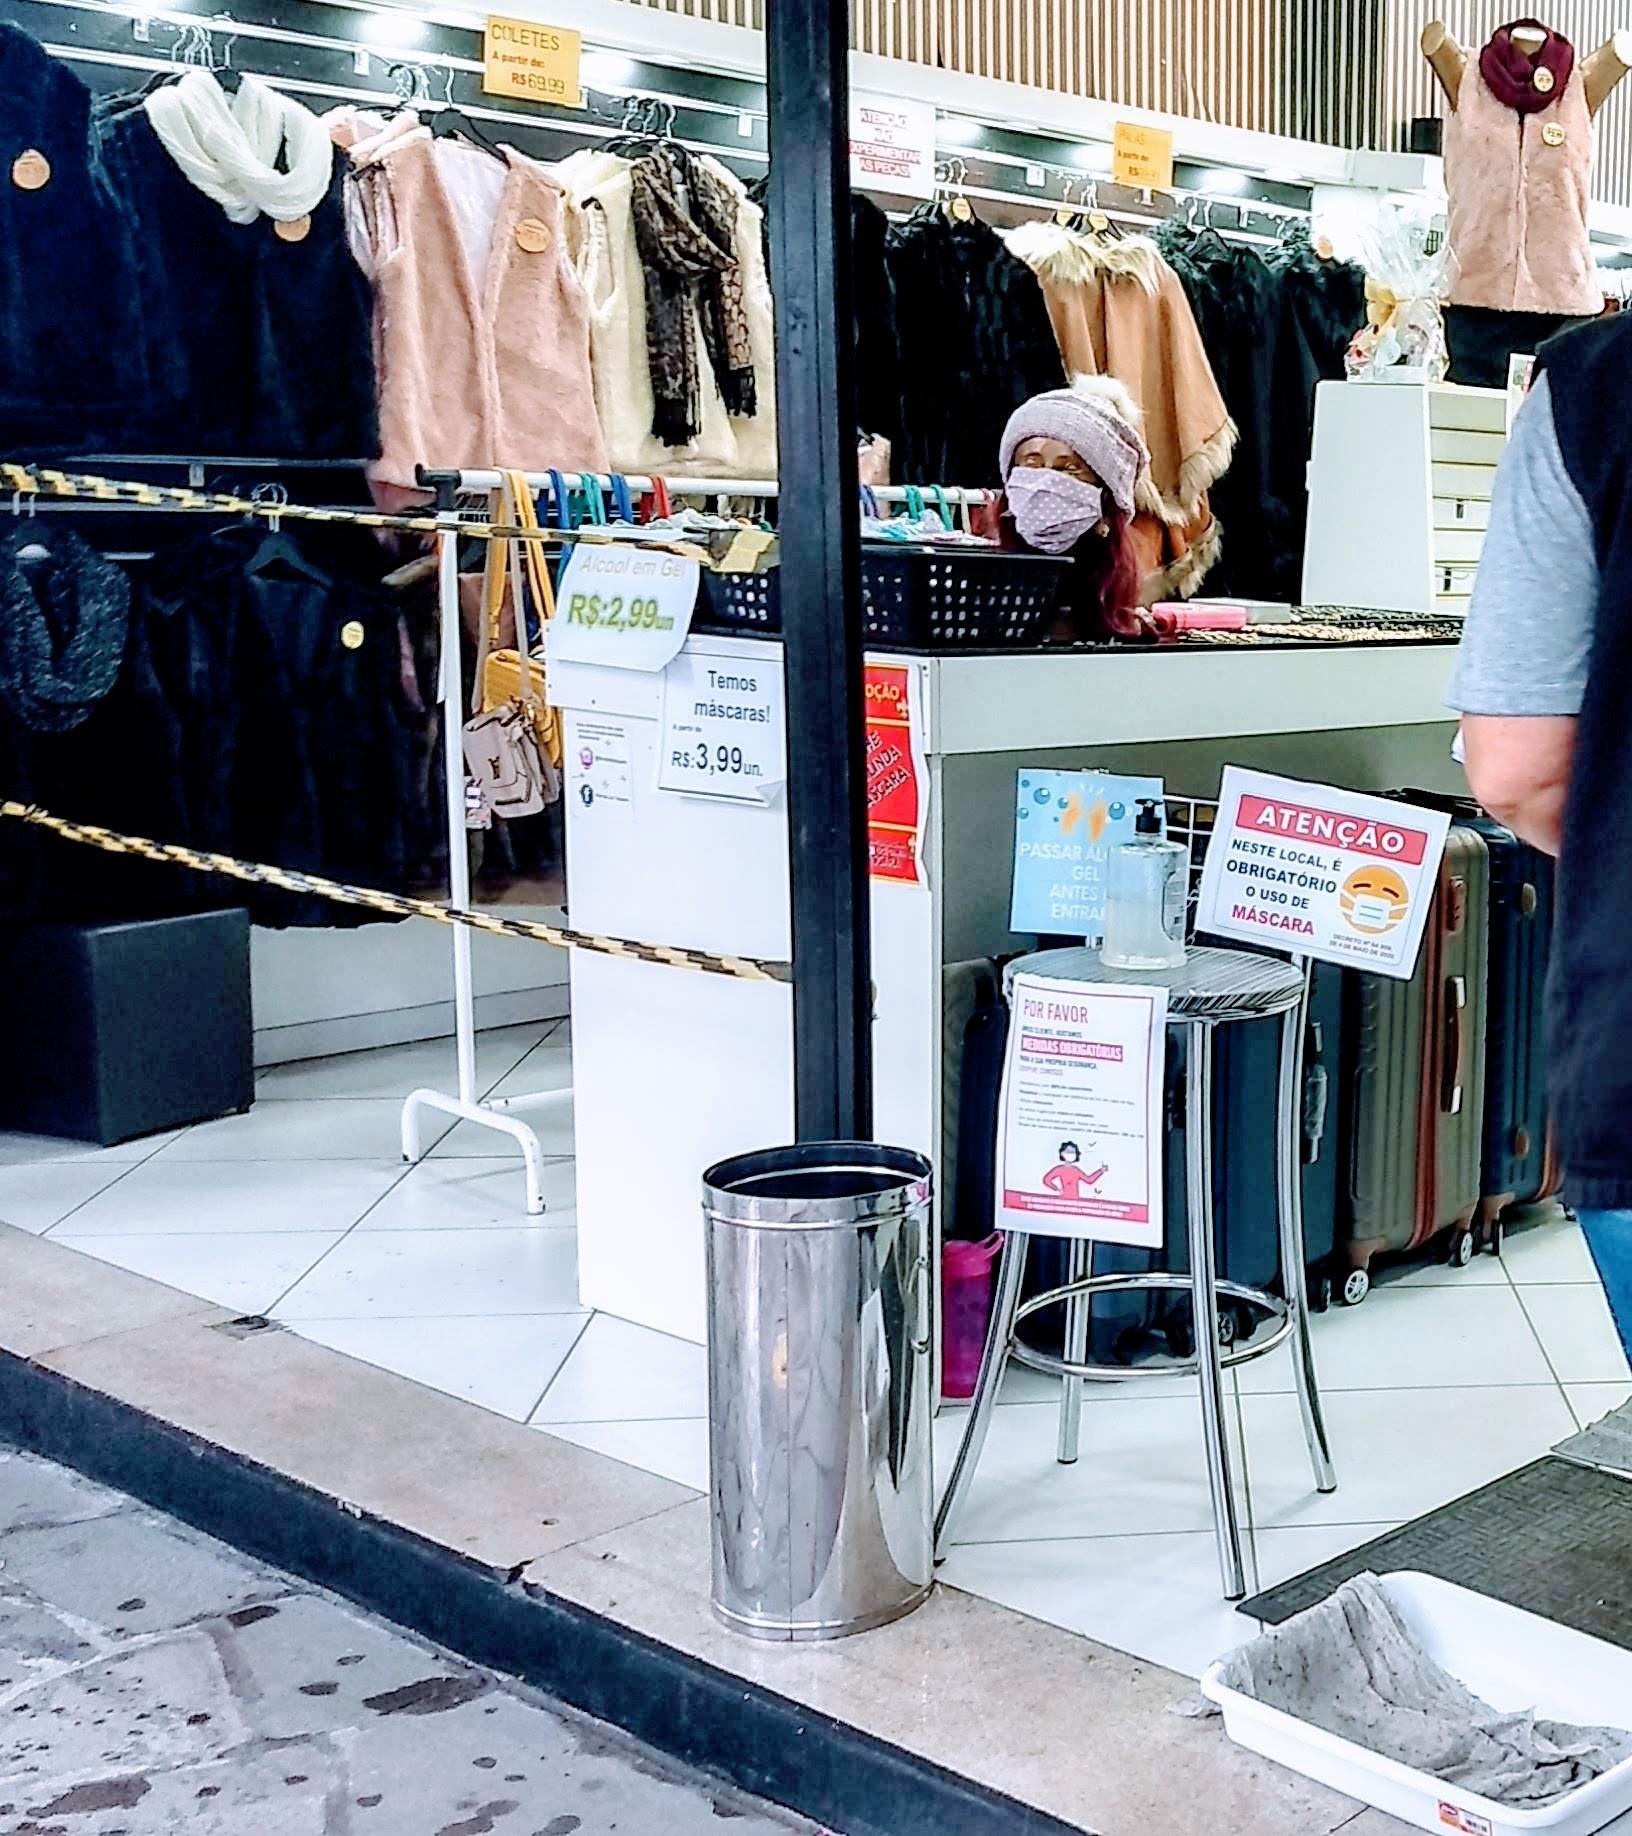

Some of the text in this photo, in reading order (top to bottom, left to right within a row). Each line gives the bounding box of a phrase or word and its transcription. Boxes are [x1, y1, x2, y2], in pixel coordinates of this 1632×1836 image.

[491, 24, 560, 51] COLETES
[492, 50, 499, 60] A
[580, 555, 687, 578] Alcool em Gel
[707, 670, 758, 692] Temos
[864, 681, 900, 703] OÇÃO
[694, 700, 771, 724] máscaras!
[1256, 804, 1405, 854] ATENÇÃO
[1020, 842, 1107, 862] PASSAR AL
[1232, 838, 1343, 872] NESTE LOCAL, É
[1072, 865, 1101, 882] GEL
[1226, 859, 1338, 894] OBRIGATÓRIO
[1049, 883, 1098, 901] ANTES
[1245, 886, 1310, 910] O USO DE
[1231, 904, 1315, 936] MÁSCARA
[1024, 999, 1089, 1024] POR FAVOR
[1060, 1040, 1121, 1060] OBRIGATÓRIAS
